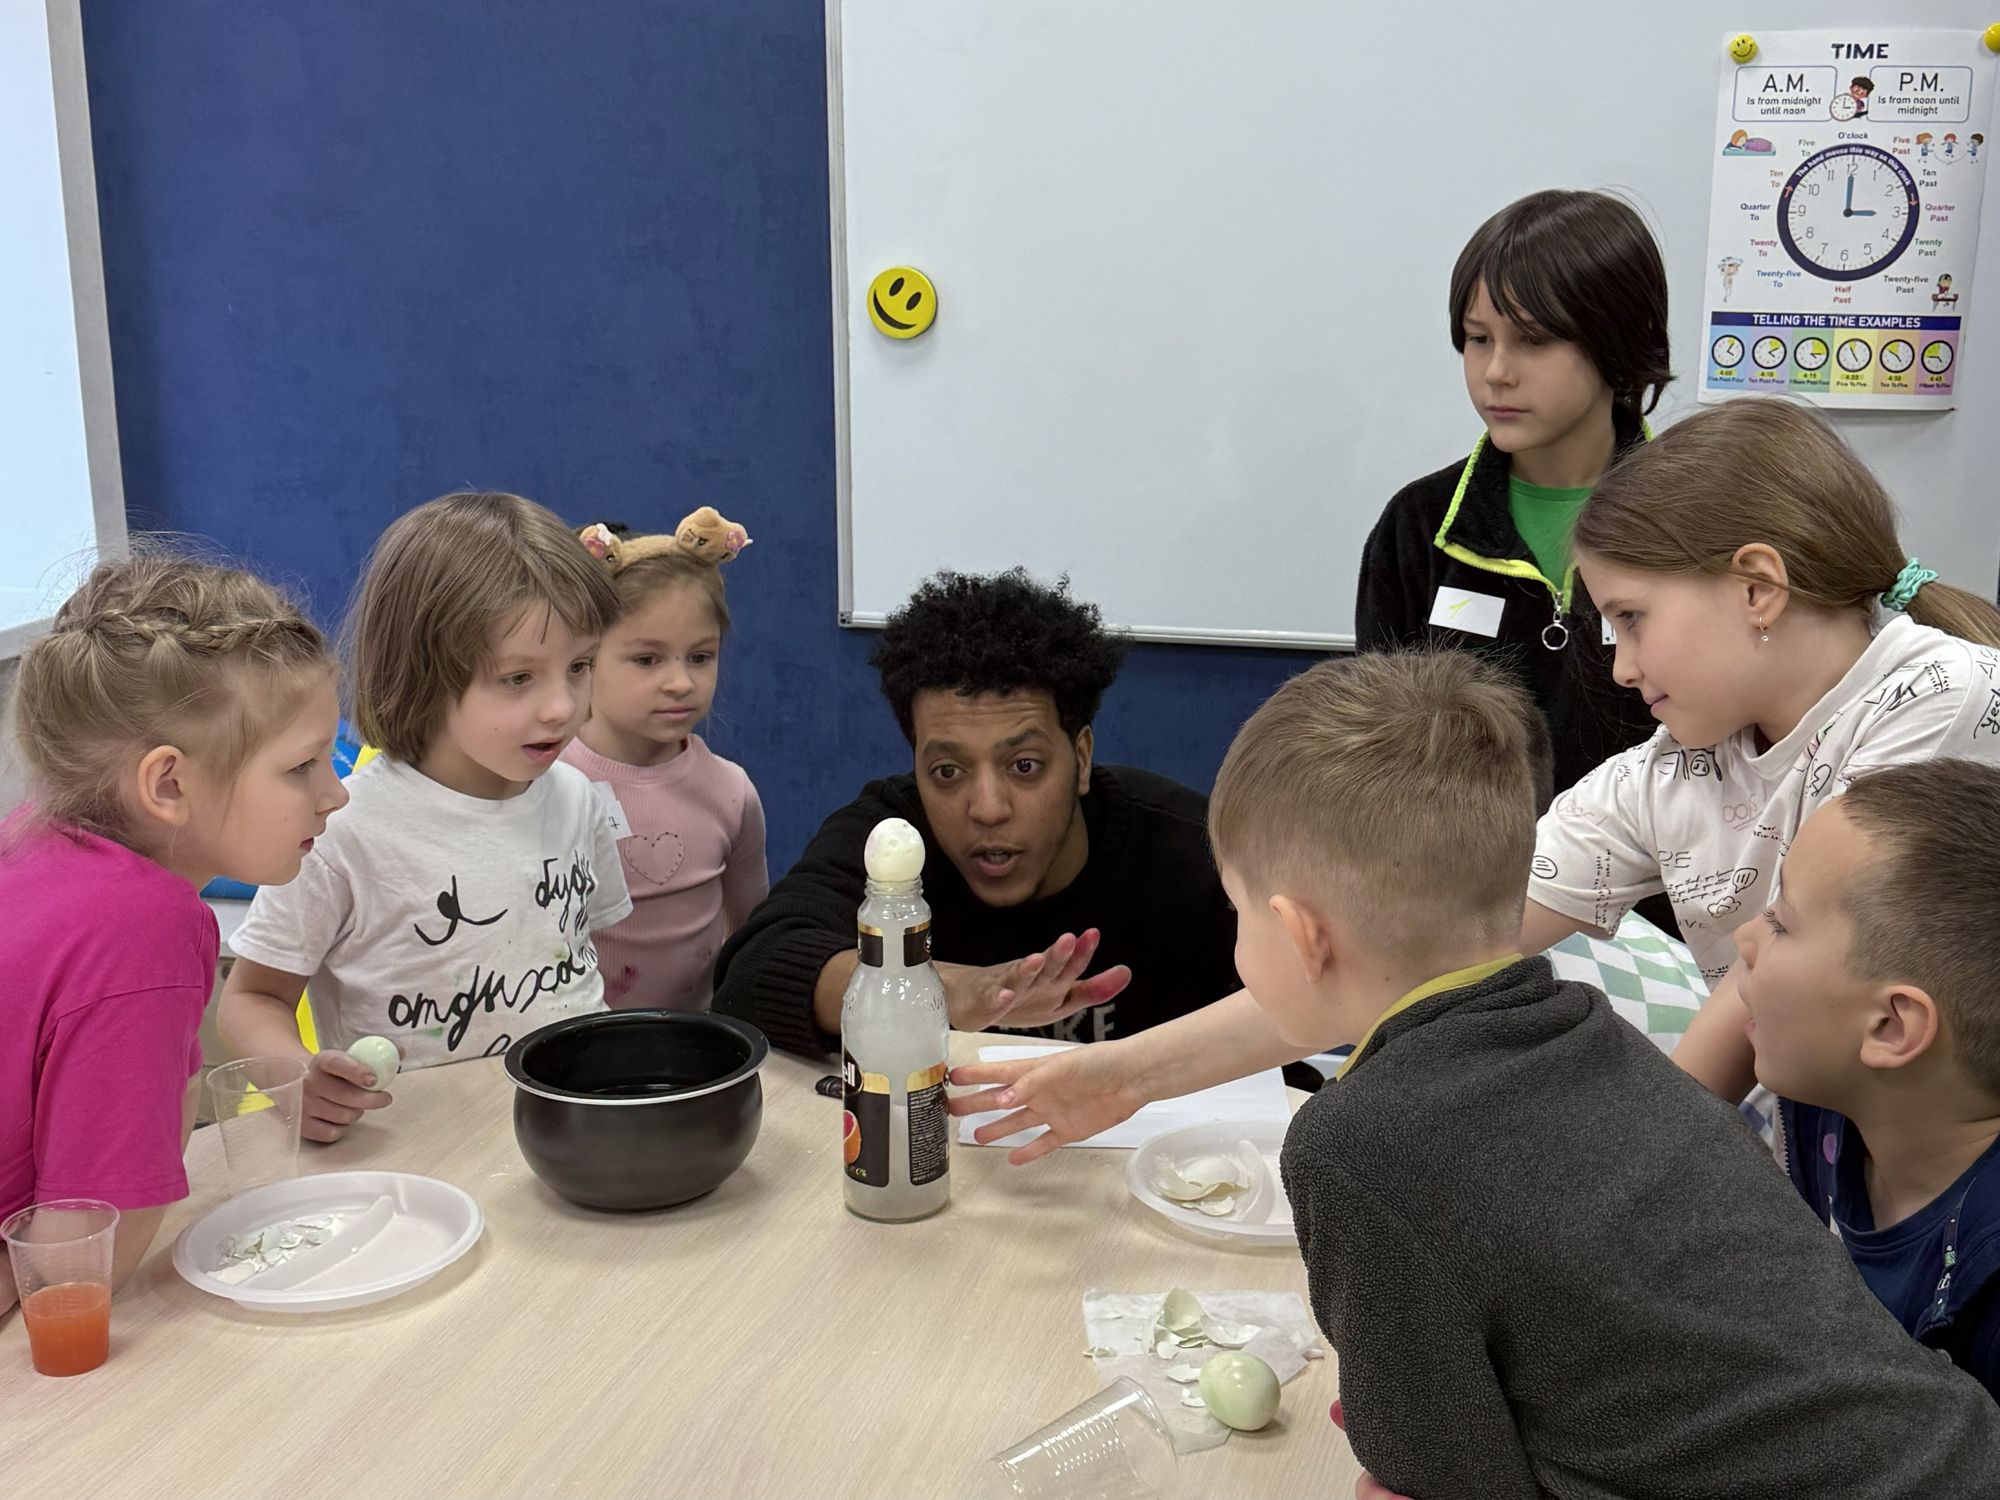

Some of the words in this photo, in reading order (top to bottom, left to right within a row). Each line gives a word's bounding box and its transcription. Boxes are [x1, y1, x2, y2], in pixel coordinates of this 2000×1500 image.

[1831, 43, 1889, 59] TIME
[1762, 73, 1810, 93] A.M.
[1899, 72, 1944, 92] P.M.
[1746, 96, 1756, 105] Is
[1757, 96, 1779, 105] from
[1781, 96, 1822, 107] midnight
[1878, 95, 1887, 104] Is
[1889, 95, 1911, 104] from
[1913, 97, 1936, 105] noon
[1938, 96, 1960, 105] until
[1760, 106, 1781, 115] until
[1783, 107, 1806, 115] noon
[1897, 106, 1939, 116] midnight
[1838, 131, 1869, 140] O'clock
[1893, 136, 1911, 144] Five
[1798, 138, 1816, 146] Five
[1801, 149, 1811, 157] To
[1892, 147, 1911, 155] Past
[1770, 169, 1784, 177] Ten
[1847, 163, 1859, 176] 12
[1922, 168, 1937, 177] Ten
[1827, 169, 1836, 182] 11
[1771, 180, 1781, 188] To
[1919, 179, 1938, 188] Past
[1808, 183, 1821, 197] 10
[1884, 184, 1894, 198] 2
[1740, 202, 1771, 211] Quarter
[1798, 204, 1807, 217] 9
[1925, 203, 1956, 211] Quarter
[1750, 213, 1760, 221] To
[1892, 206, 1901, 219] 3
[1930, 214, 1949, 222] Past
[1805, 226, 1815, 239] 8
[1881, 227, 1890, 240] 4
[1750, 239, 1778, 248] Twenty
[1915, 238, 1943, 247] Twenty
[1758, 249, 1768, 257] To
[1820, 242, 1829, 255] 7
[1863, 242, 1873, 256] 5
[1918, 249, 1937, 257] Past
[1840, 249, 1849, 262] 6
[1756, 269, 1802, 279] Twenty-five
[1773, 280, 1783, 288] To
[1884, 275, 1929, 285] Twenty-five
[1834, 285, 1852, 293] Half
[1896, 285, 1915, 294] Past
[1832, 296, 1852, 304] Past
[1753, 314, 1800, 326] TELLING
[1803, 315, 1826, 327] THE
[1828, 316, 1856, 328] TIME
[1858, 316, 1921, 329] EXAMPLES
